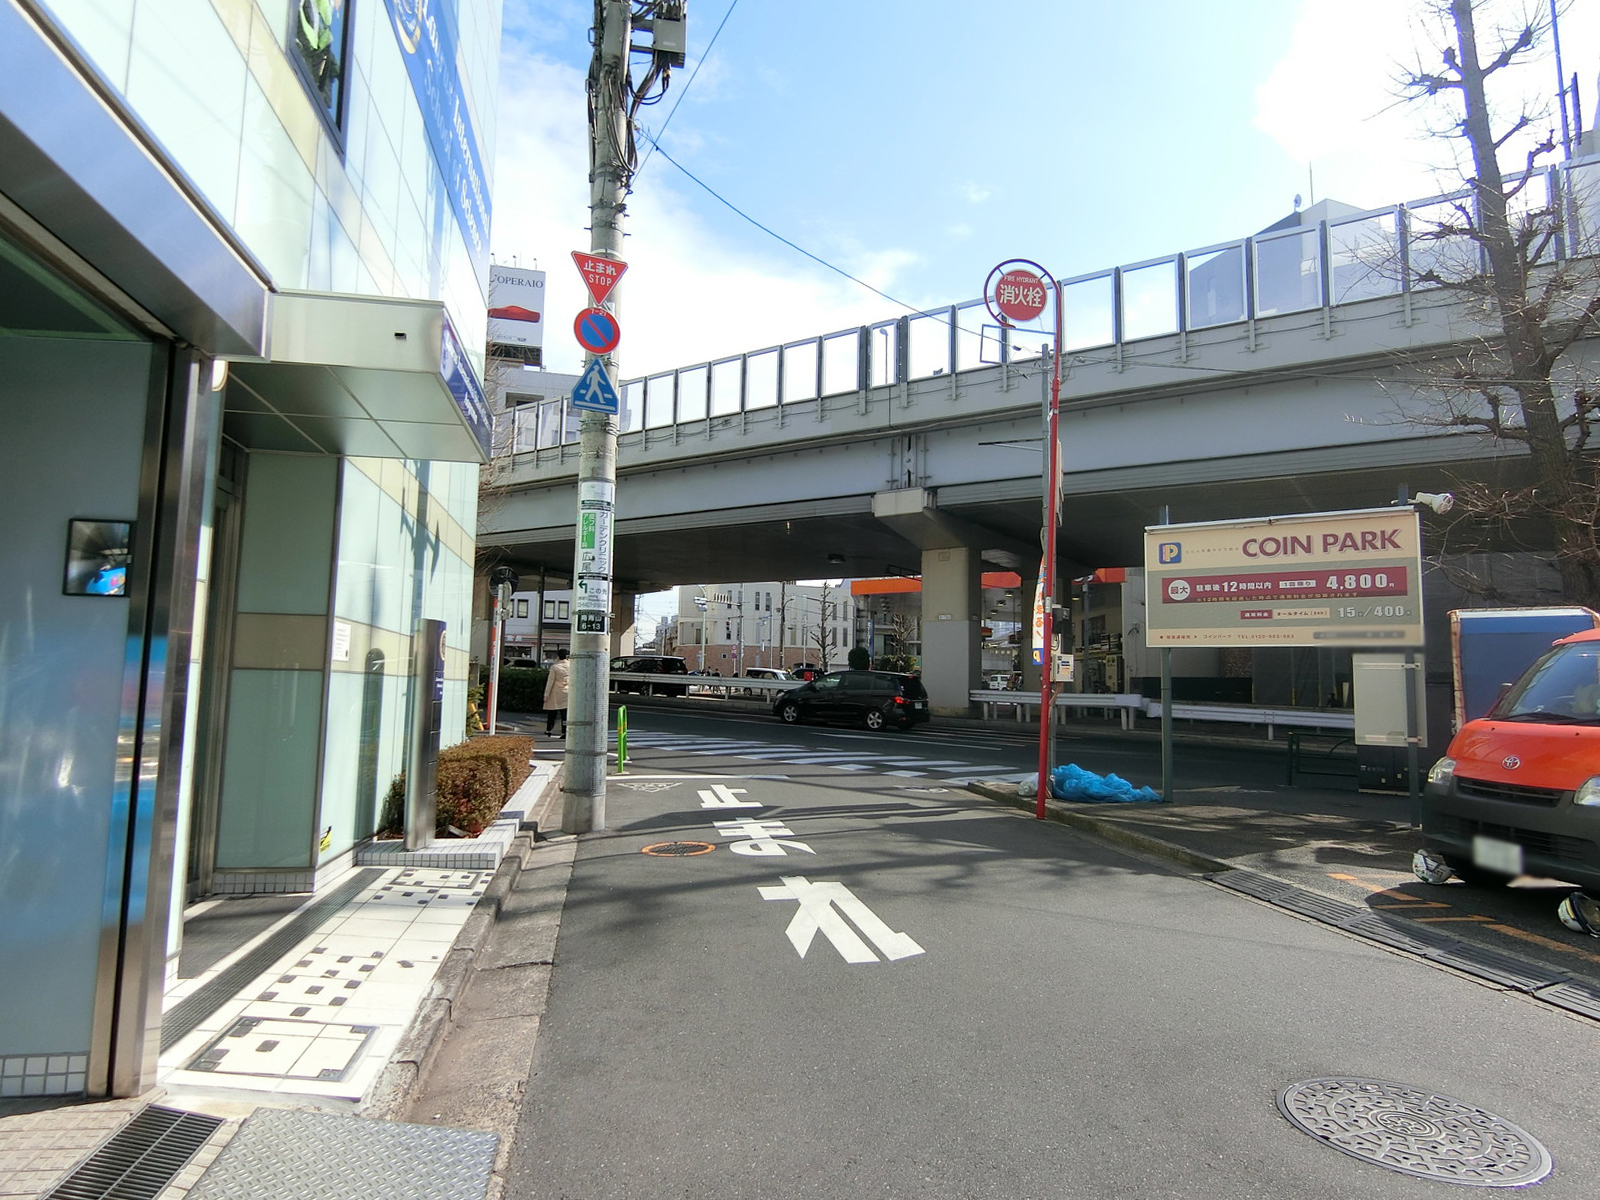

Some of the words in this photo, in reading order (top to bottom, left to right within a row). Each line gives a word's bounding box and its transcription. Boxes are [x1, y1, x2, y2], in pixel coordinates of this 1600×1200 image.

[583, 260, 617, 276] 止まれ
[589, 274, 612, 286] STOP
[1000, 284, 1043, 307] 消火栓
[1242, 535, 1312, 558] COIN
[1322, 529, 1402, 553] PARK
[1170, 585, 1189, 596] 最大
[582, 622, 601, 630] 6-13
